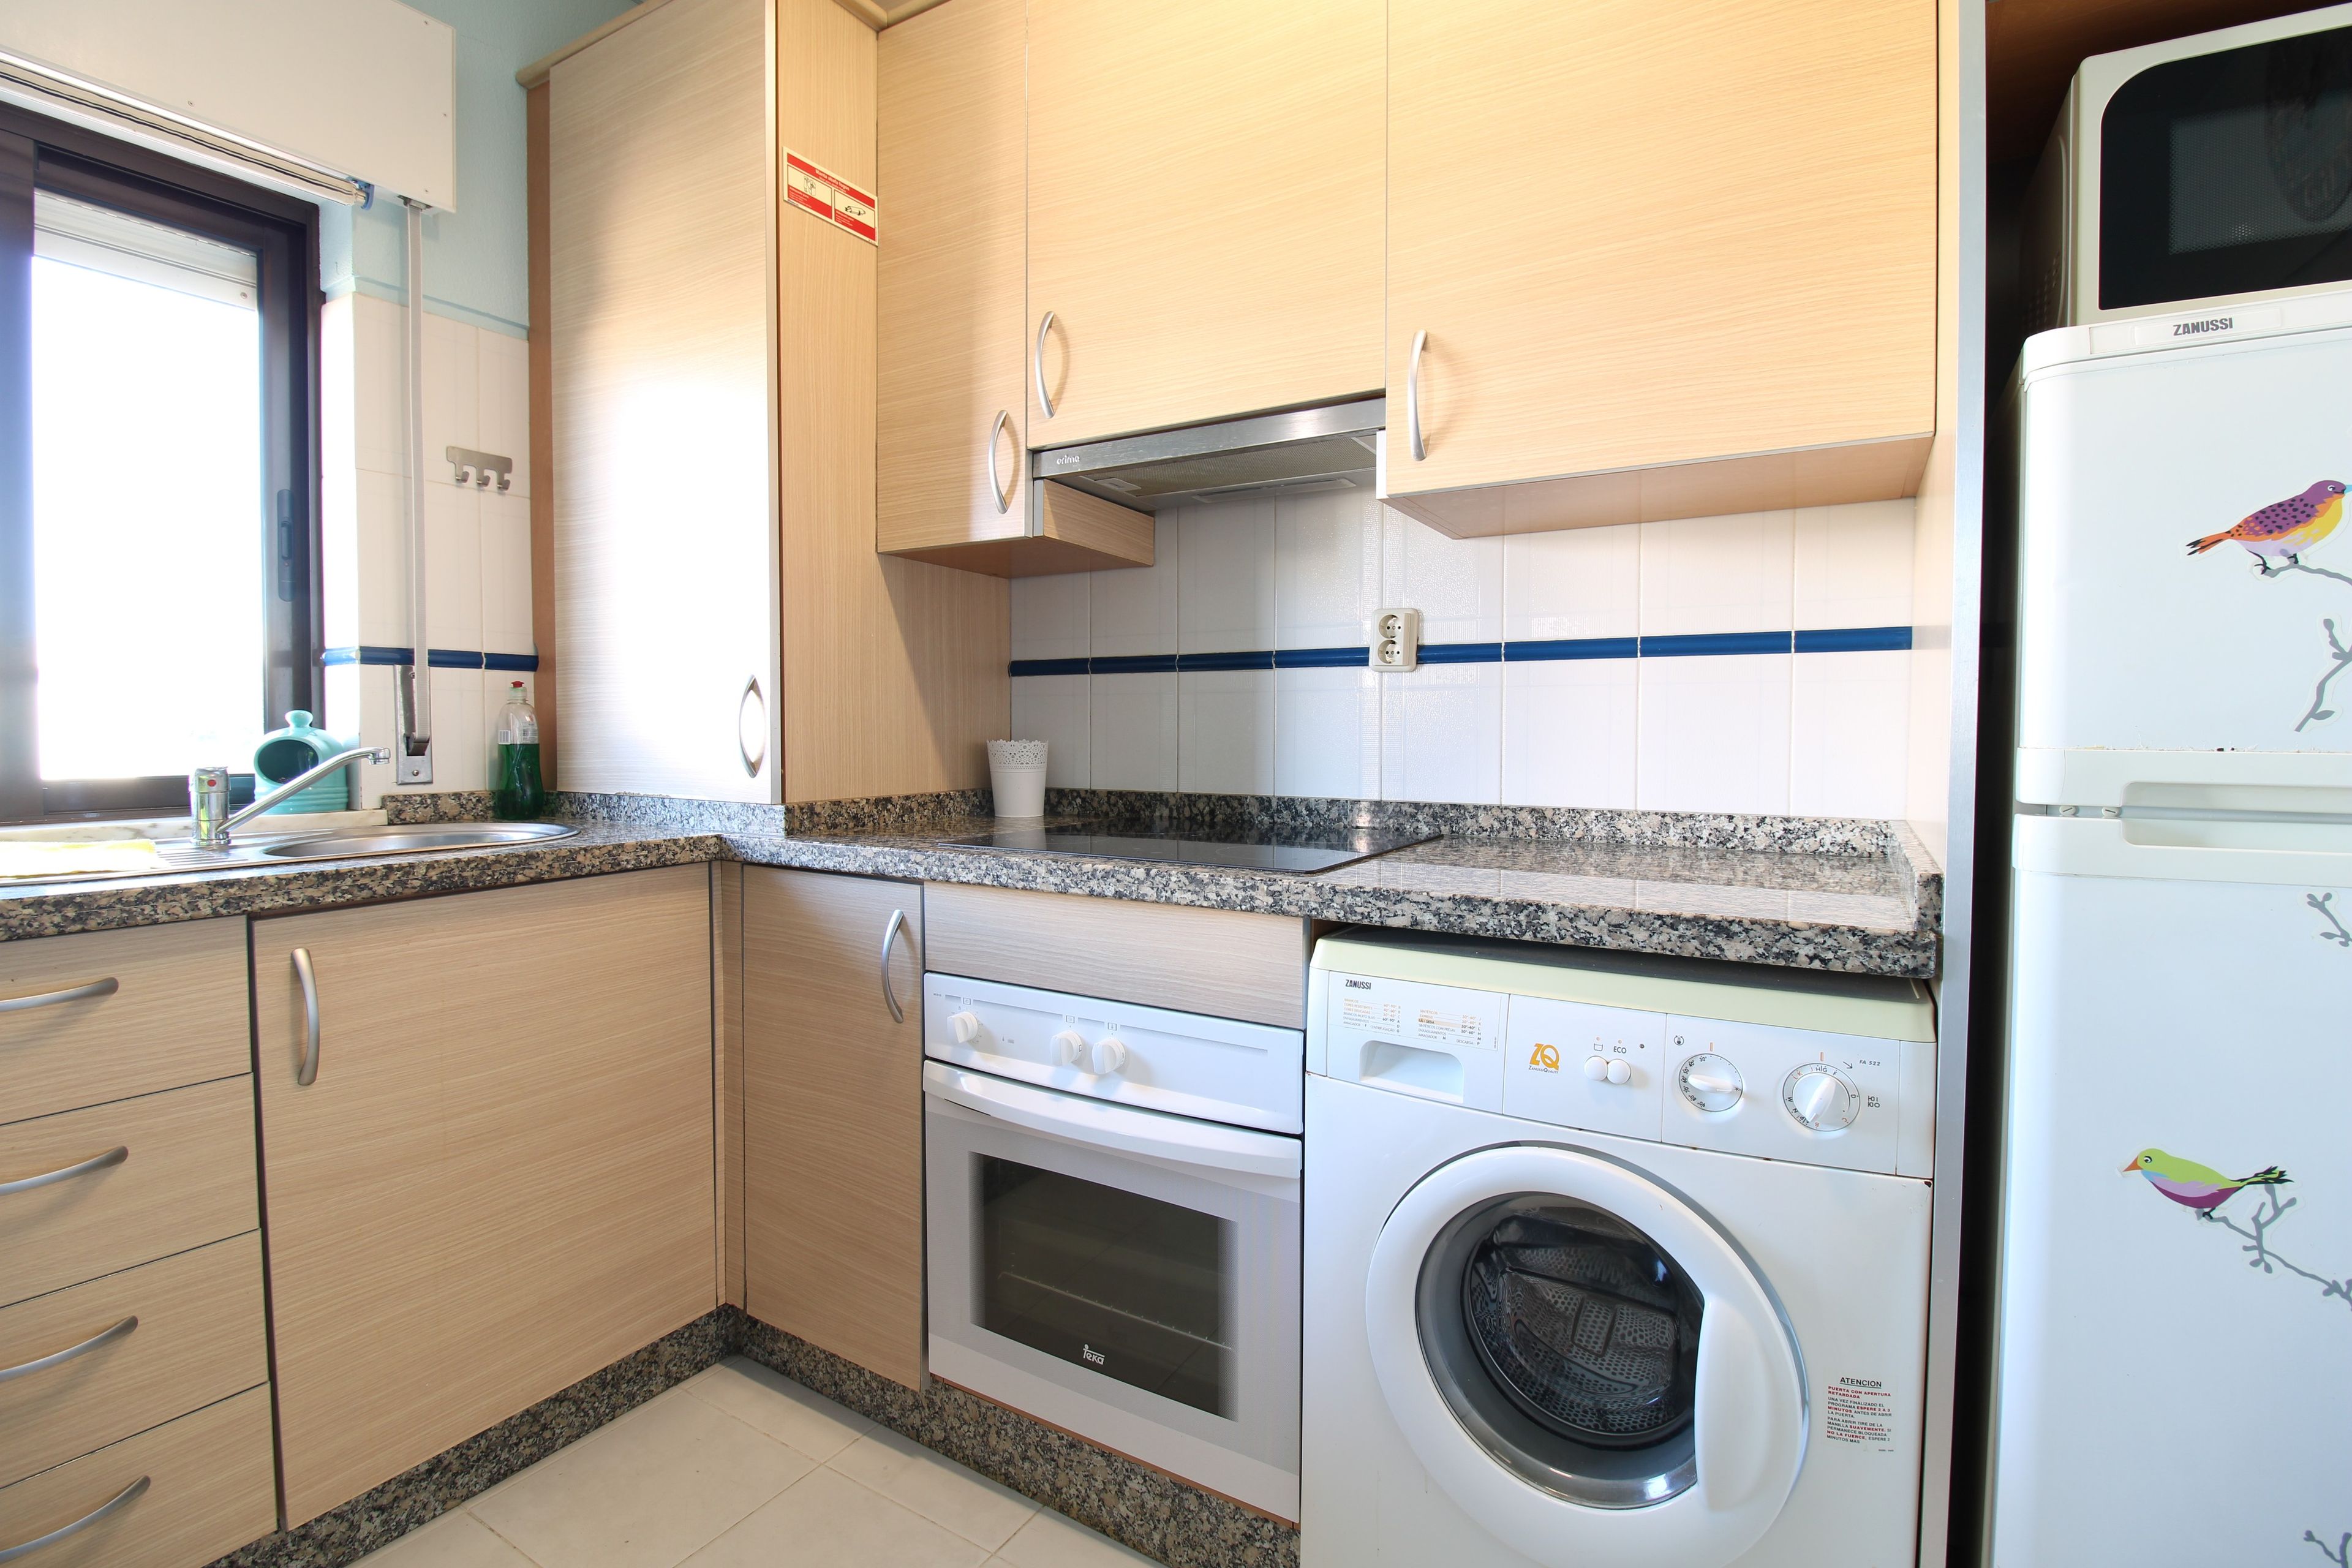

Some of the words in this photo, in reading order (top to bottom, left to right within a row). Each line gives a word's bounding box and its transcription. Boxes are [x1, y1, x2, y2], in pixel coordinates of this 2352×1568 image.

[2173, 317, 2233, 336] ZANUSSI
[1345, 979, 1371, 990] ZANUSSI
[1613, 1046, 1627, 1054] ECO
[1840, 1377, 1882, 1387] ATENCION
[1827, 1425, 1858, 1434] PERMANECE
